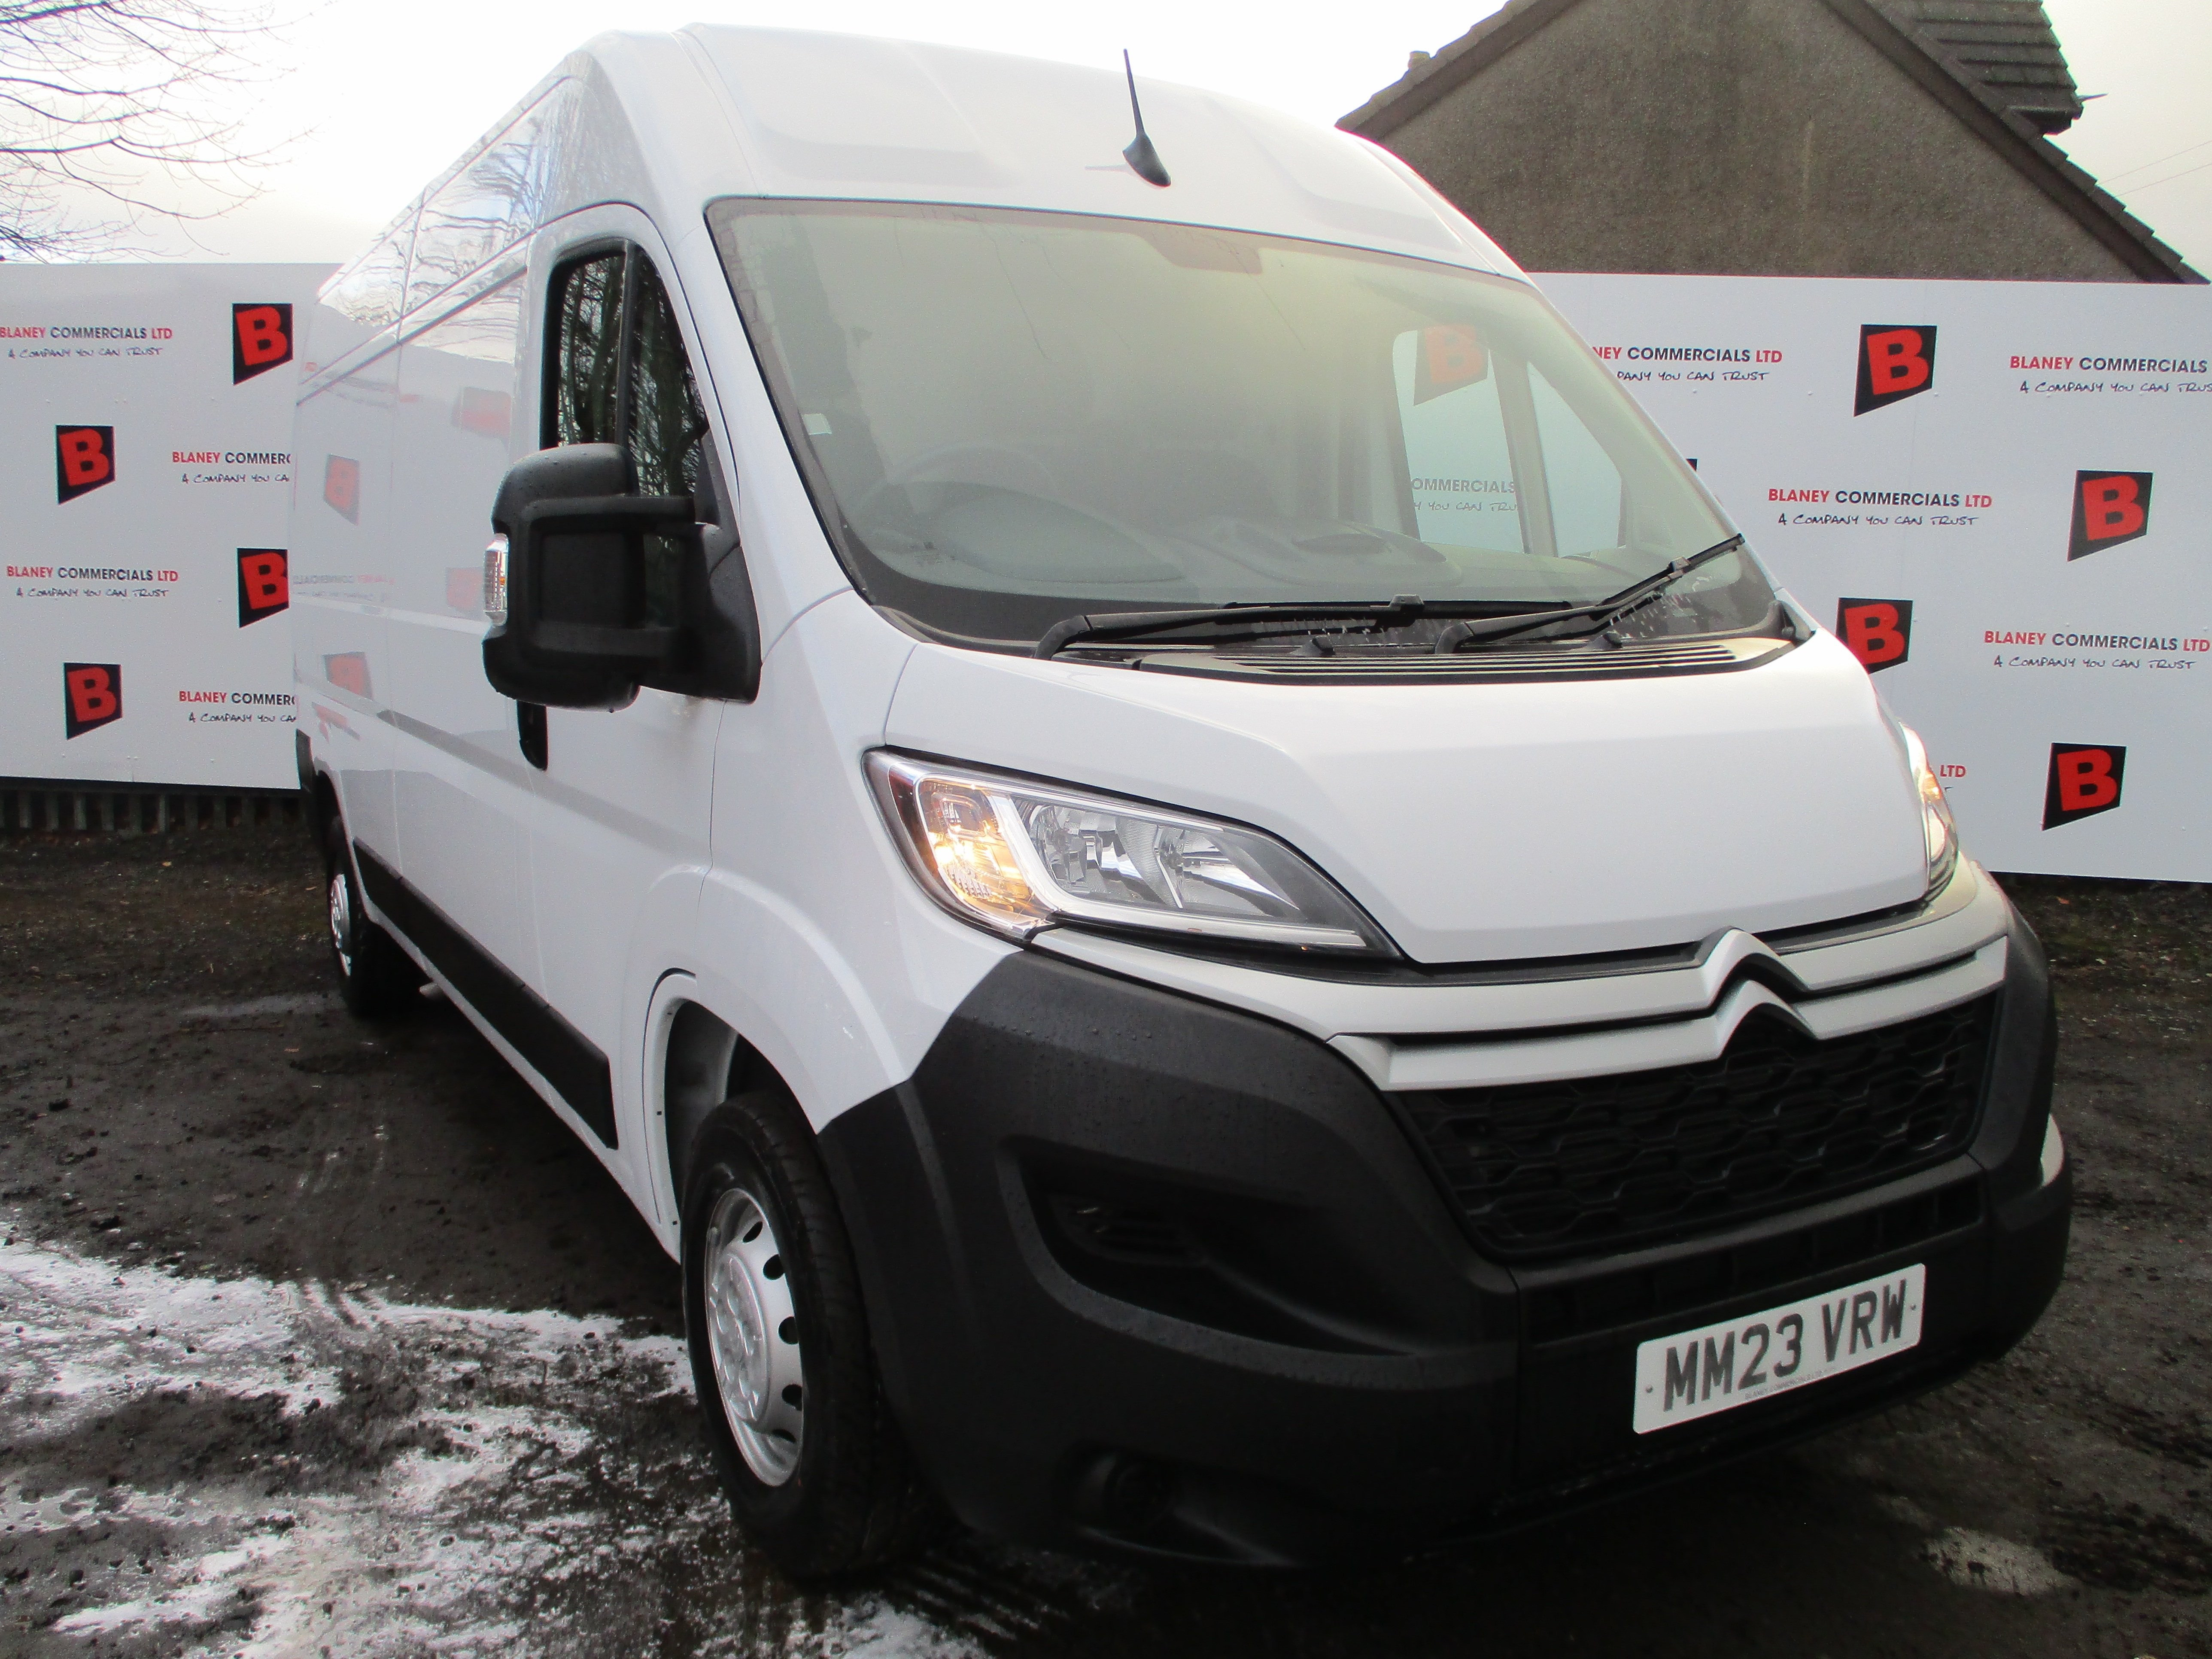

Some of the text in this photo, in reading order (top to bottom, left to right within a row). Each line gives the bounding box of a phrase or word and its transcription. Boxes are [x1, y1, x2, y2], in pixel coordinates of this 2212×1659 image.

[0, 326, 173, 339] BLANEY COMMERCIALS LTD
[236, 306, 288, 366] B
[19, 348, 70, 358] COMPANY
[126, 346, 163, 356] TRUST
[1424, 325, 1483, 385] B
[1627, 346, 1751, 362] COMMERCIALS
[1756, 350, 1782, 363] LTD
[1867, 329, 1929, 395] B
[2010, 356, 2209, 373] BLANEY COMMERCIALS
[1658, 371, 1681, 381] YOU
[1686, 371, 1714, 381] CAN
[1722, 371, 1770, 381] TRUST
[2035, 382, 2103, 392] COMPANY
[2111, 383, 2134, 392] YOU
[2140, 383, 2169, 392] CAN
[59, 429, 109, 486] B
[172, 452, 221, 463] BLANEY
[193, 474, 246, 483] COMPANY
[1428, 501, 1449, 510] YOU
[1456, 502, 1481, 511] CAN
[1768, 489, 1992, 507] BLANEY COMMERCIALS LTD
[2082, 475, 2144, 541] B
[1793, 514, 1859, 525] COMPANY
[1866, 516, 1889, 525] YOU
[1894, 516, 1923, 525] CAN
[1930, 516, 1978, 525] TRUST
[7, 566, 178, 581] BLANEY COMMERCIALS LTD
[241, 552, 289, 610] B
[27, 588, 78, 597] COMPANY
[132, 589, 169, 597] TRUST
[1844, 603, 1905, 665] B
[1984, 631, 2210, 652] BLANEY COMMERCIALS LTD
[2009, 656, 2076, 667] COMPANY
[2083, 659, 2105, 667] YOU
[2112, 659, 2140, 668] CAN
[2148, 659, 2196, 669] TRUST
[67, 667, 117, 722] B
[179, 691, 227, 703] BLANEY
[200, 713, 252, 722] COMPANY
[1940, 765, 1966, 778] LTD
[2057, 749, 2118, 811] B
[1663, 1279, 1907, 1412] MM23 VRW
